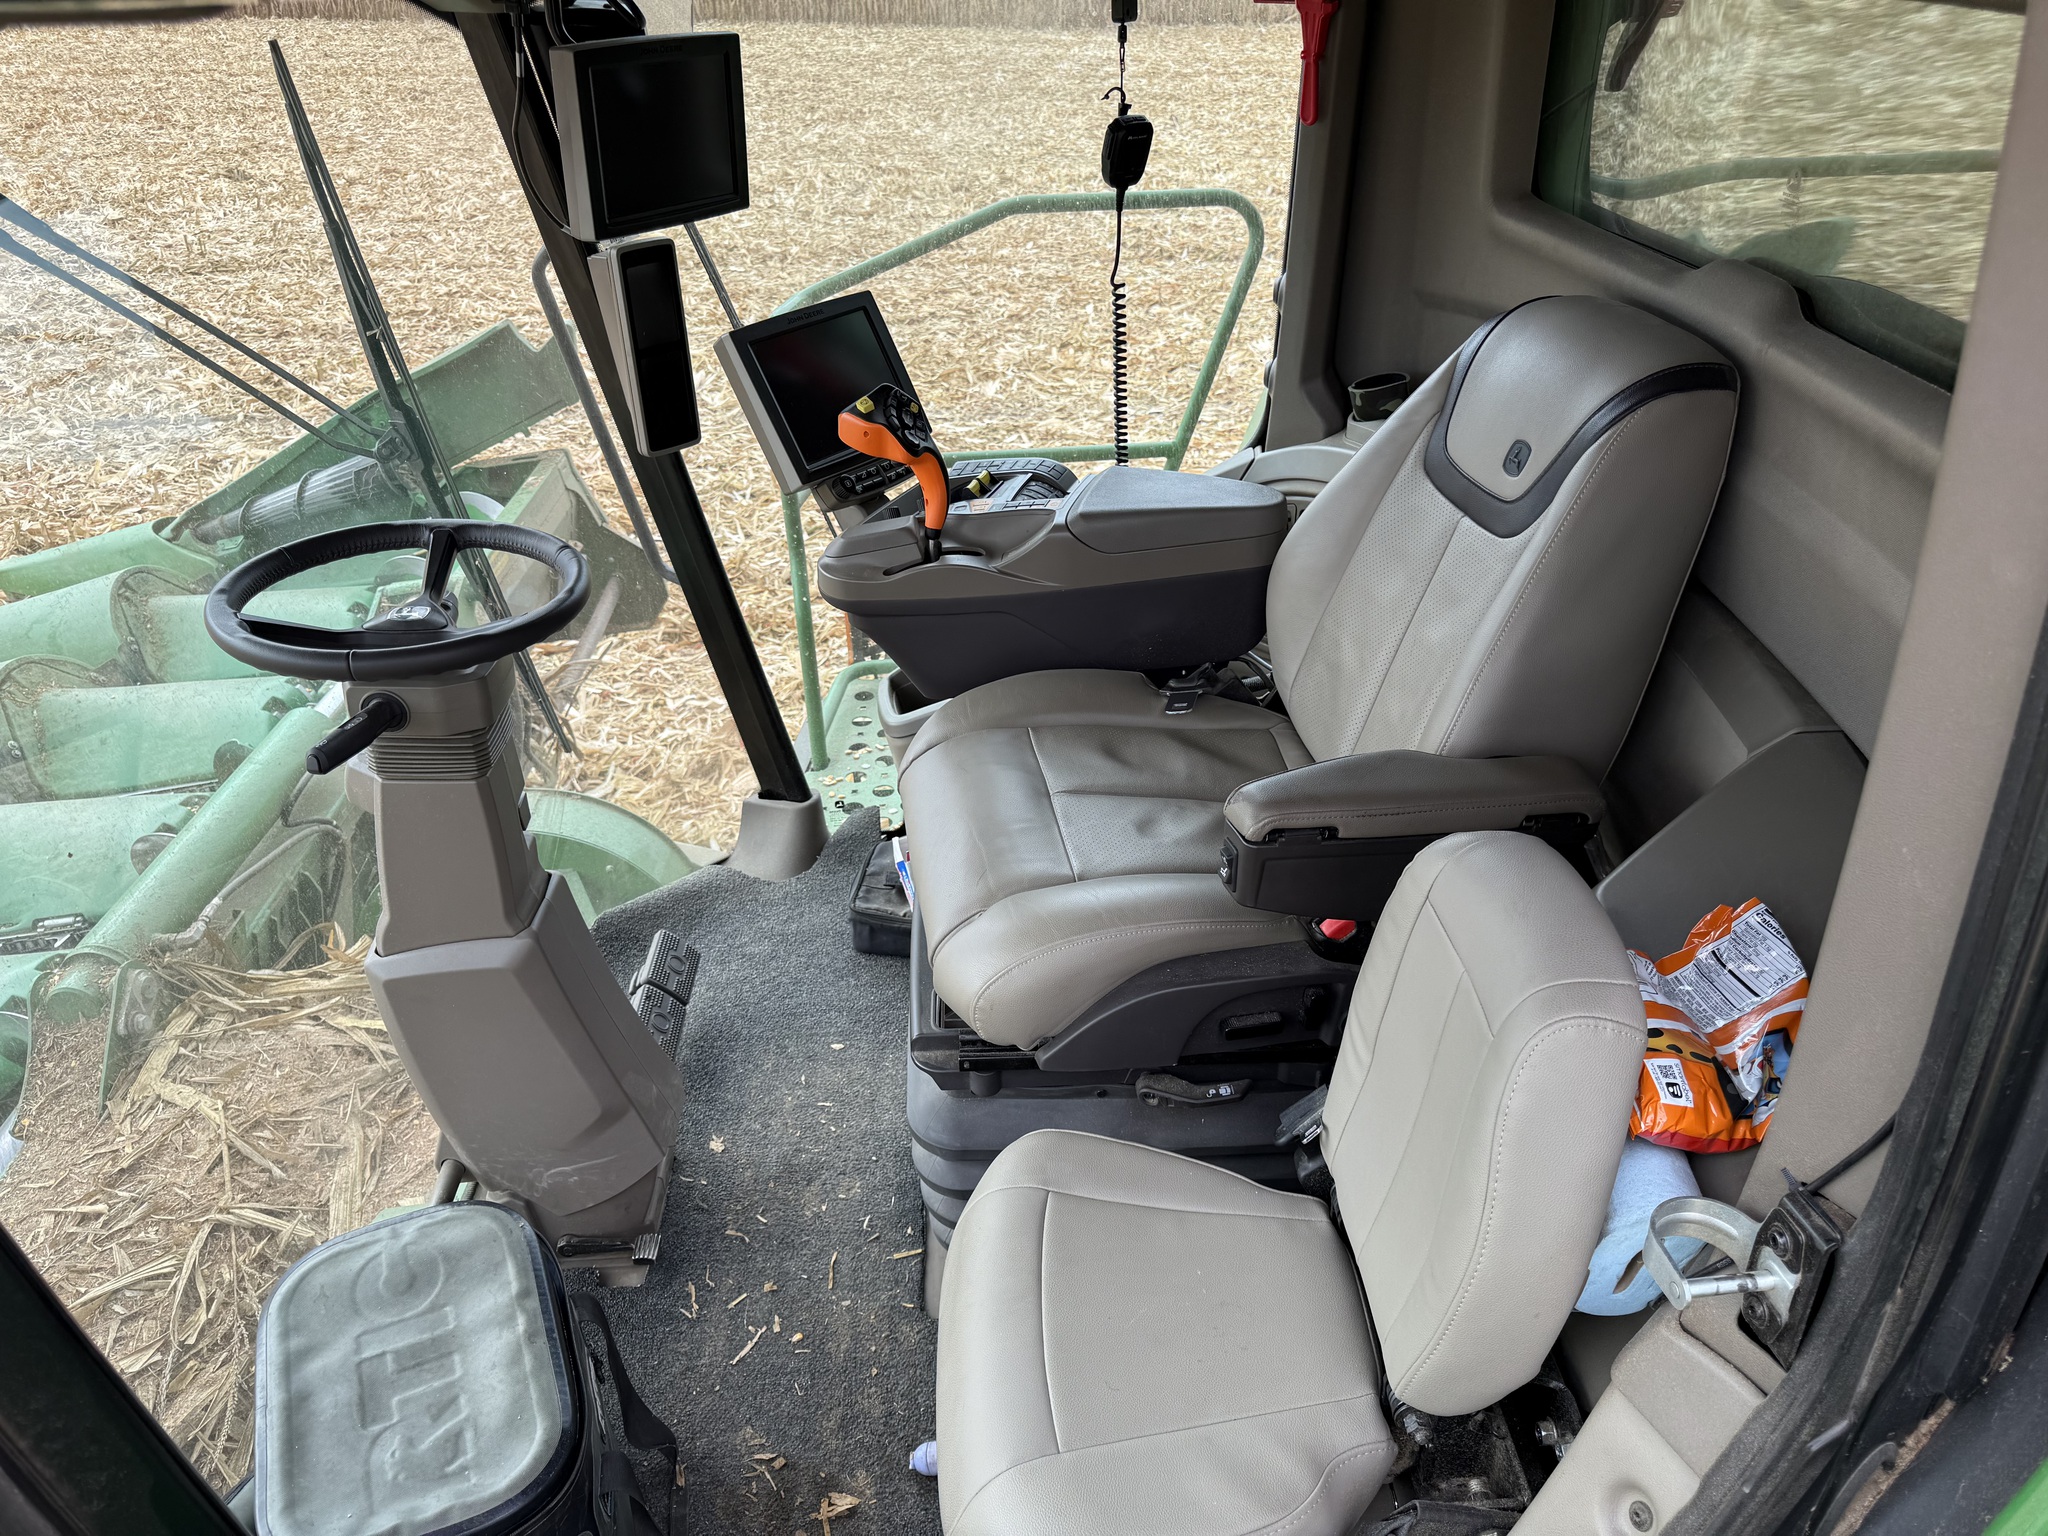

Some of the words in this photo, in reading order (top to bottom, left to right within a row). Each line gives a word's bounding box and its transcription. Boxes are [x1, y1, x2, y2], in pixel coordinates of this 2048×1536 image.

[787, 315, 804, 324] JOHN
[804, 309, 824, 319] DEERE
[1756, 912, 1786, 940] Calories
